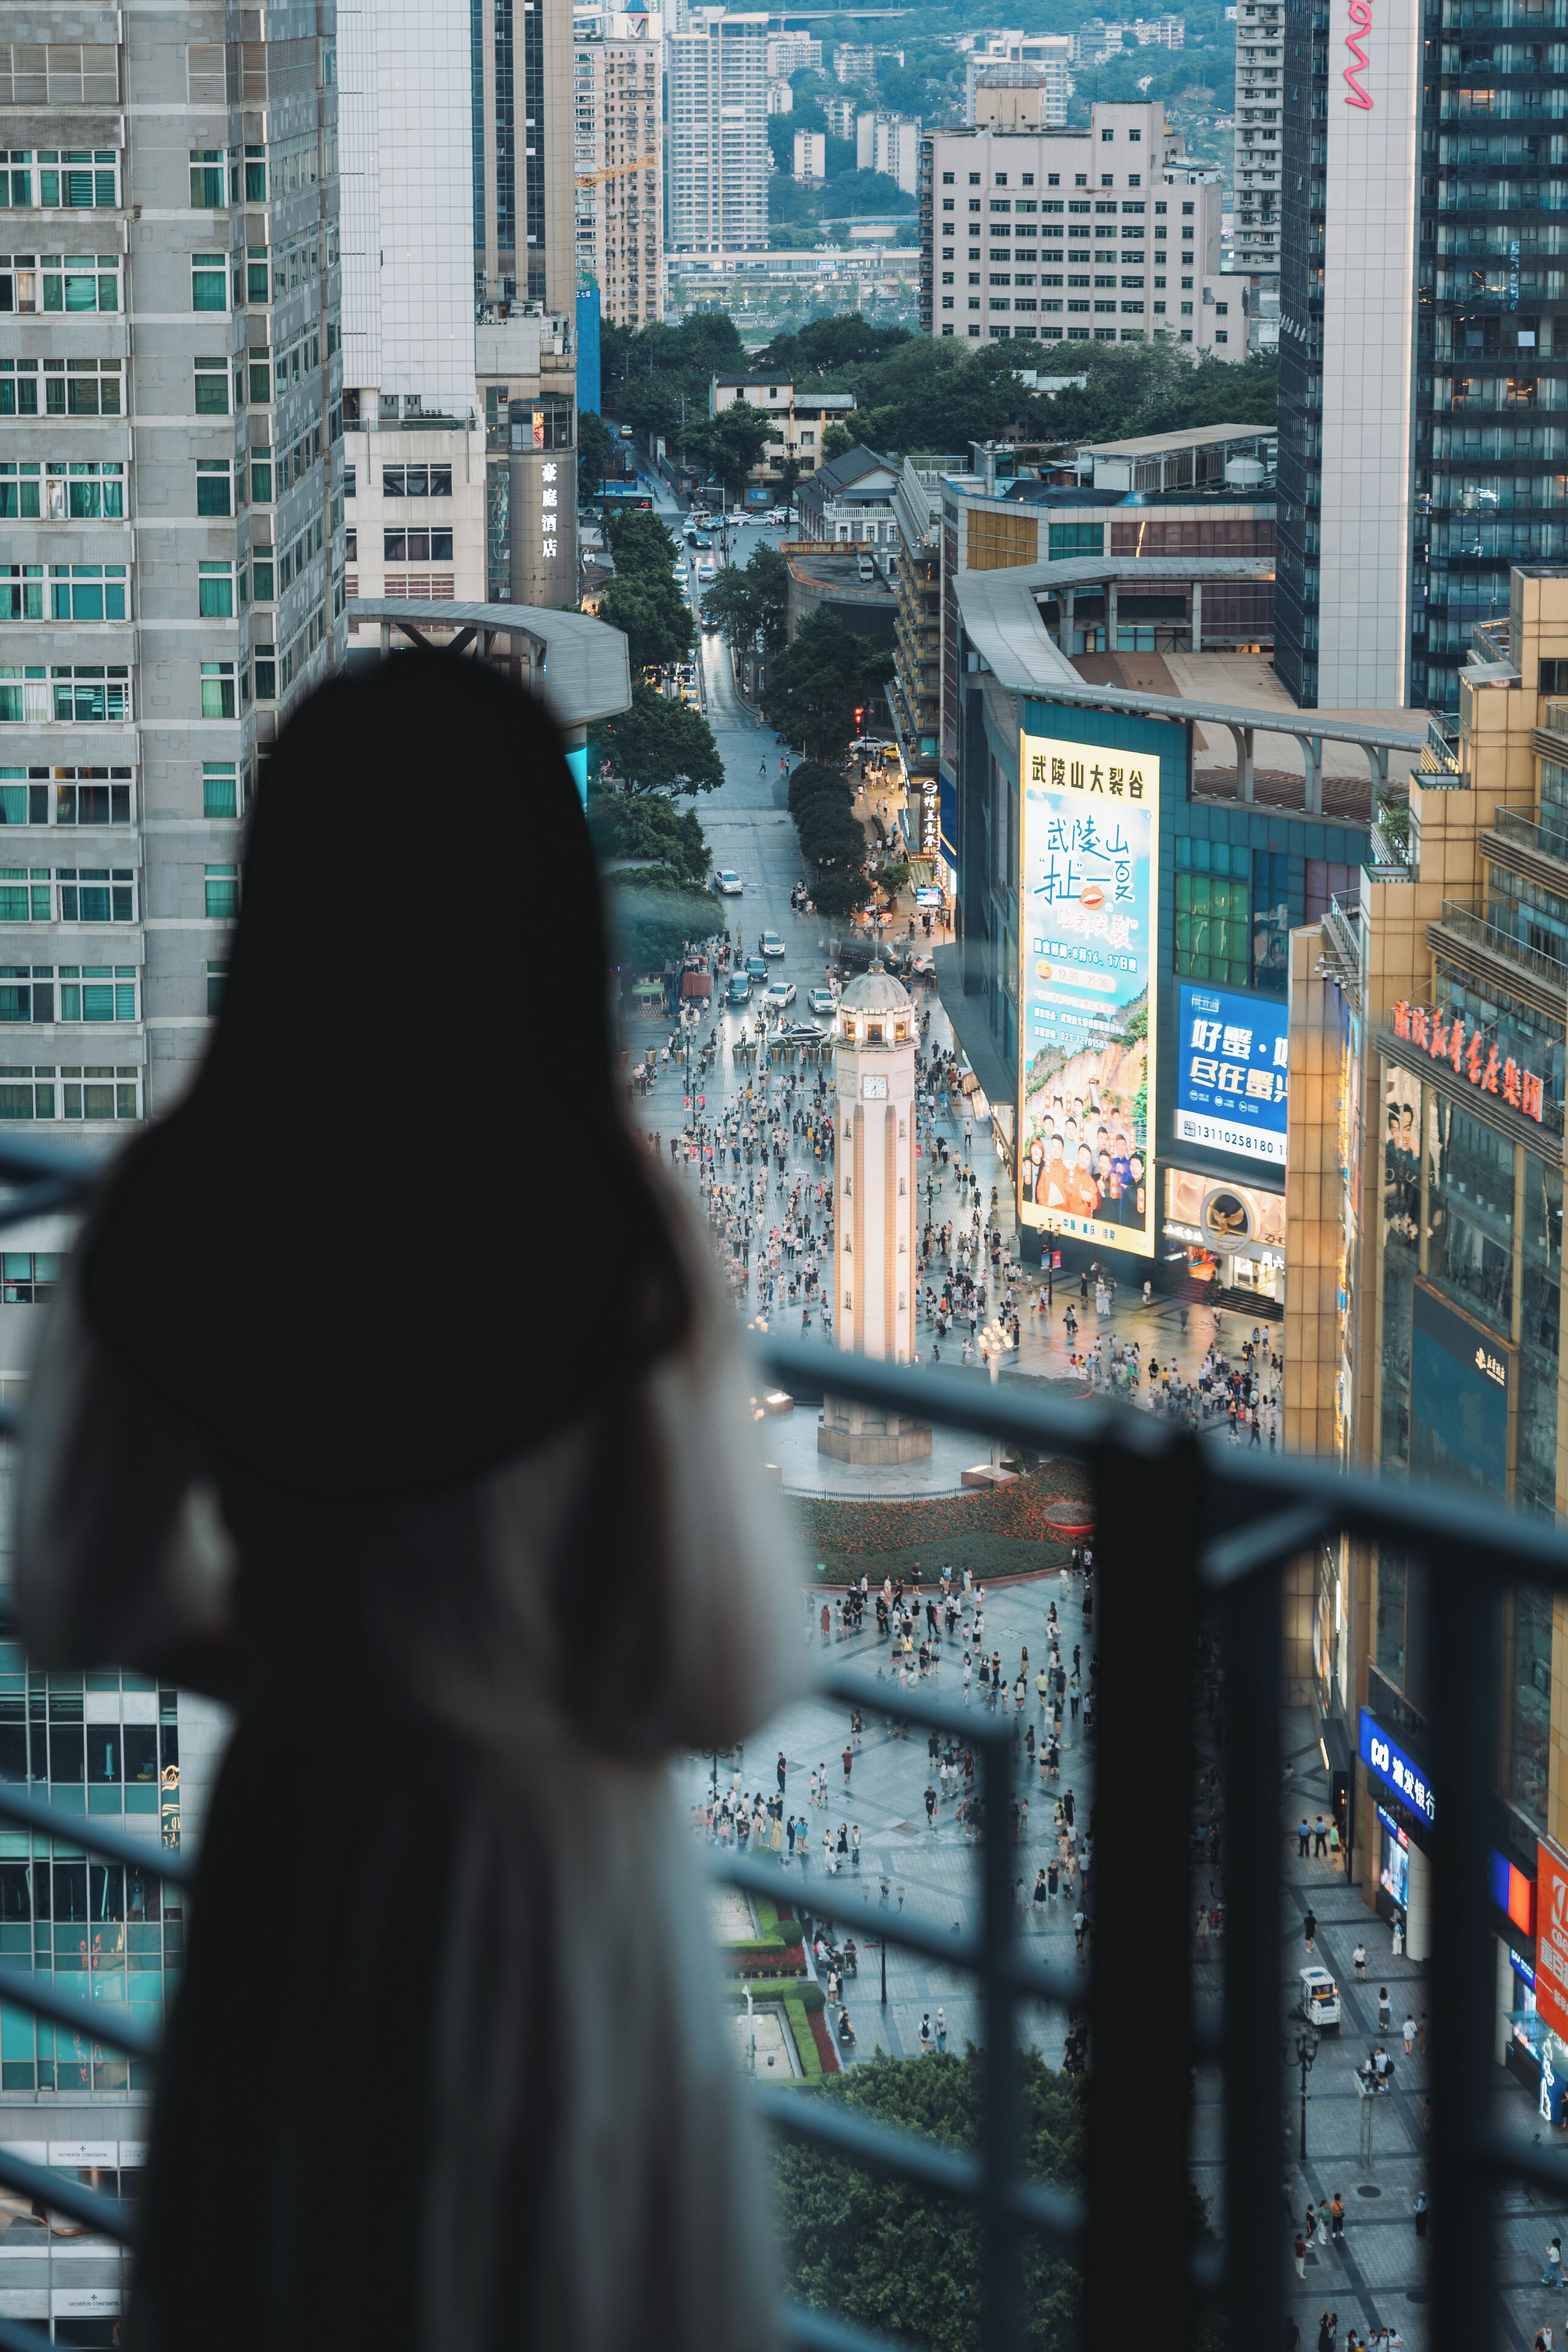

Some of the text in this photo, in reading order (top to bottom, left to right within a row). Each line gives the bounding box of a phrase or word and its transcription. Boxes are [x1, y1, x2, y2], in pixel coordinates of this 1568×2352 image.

[541, 462, 558, 558] 豪庭酒店
[1032, 755, 1144, 799] 武陵山大裂谷
[1047, 815, 1129, 862] 武陵山
[1197, 1125, 1273, 1153] 13110258180
[1392, 1756, 1436, 1821] 浦发银行
[1553, 1989, 1568, 2015] 新华
